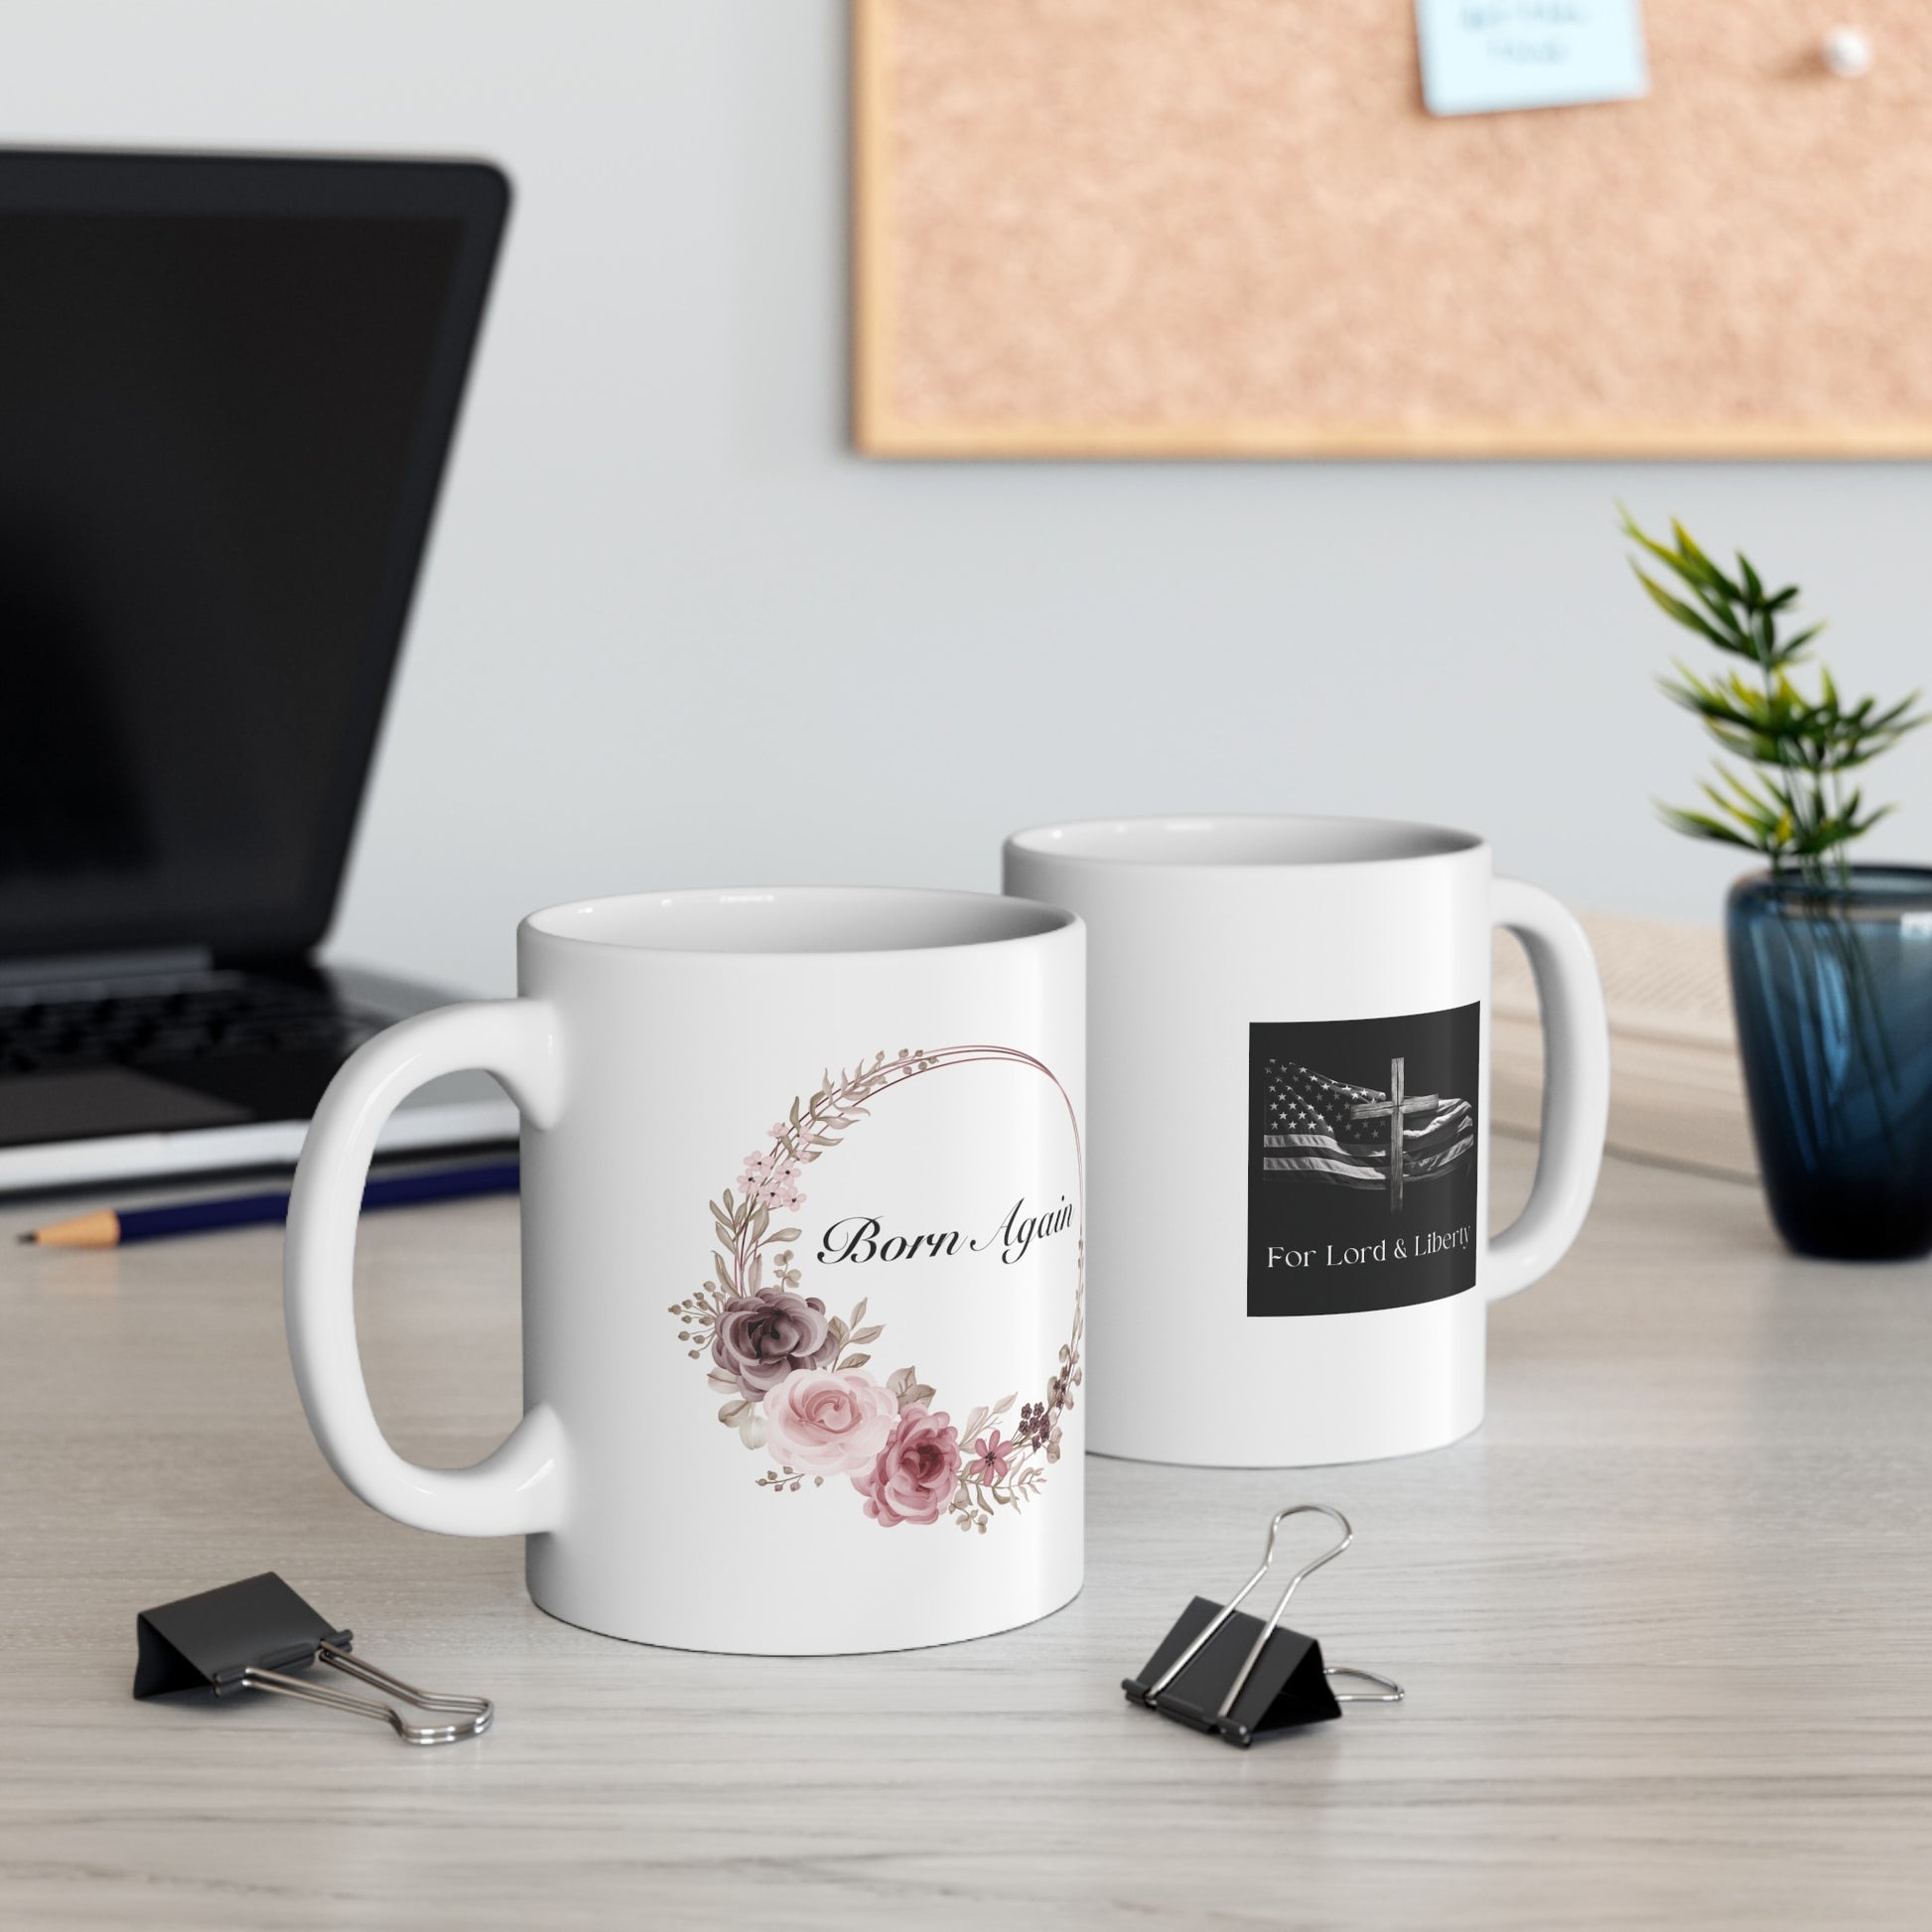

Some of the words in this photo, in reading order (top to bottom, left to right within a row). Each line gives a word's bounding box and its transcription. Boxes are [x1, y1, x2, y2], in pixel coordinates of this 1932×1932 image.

[817, 1215, 968, 1264] Born
[970, 1194, 1074, 1265] Again
[1268, 1246, 1316, 1268] For
[1326, 1239, 1387, 1266] Lord
[1393, 1238, 1408, 1259] &
[1415, 1225, 1471, 1257] Liberty
